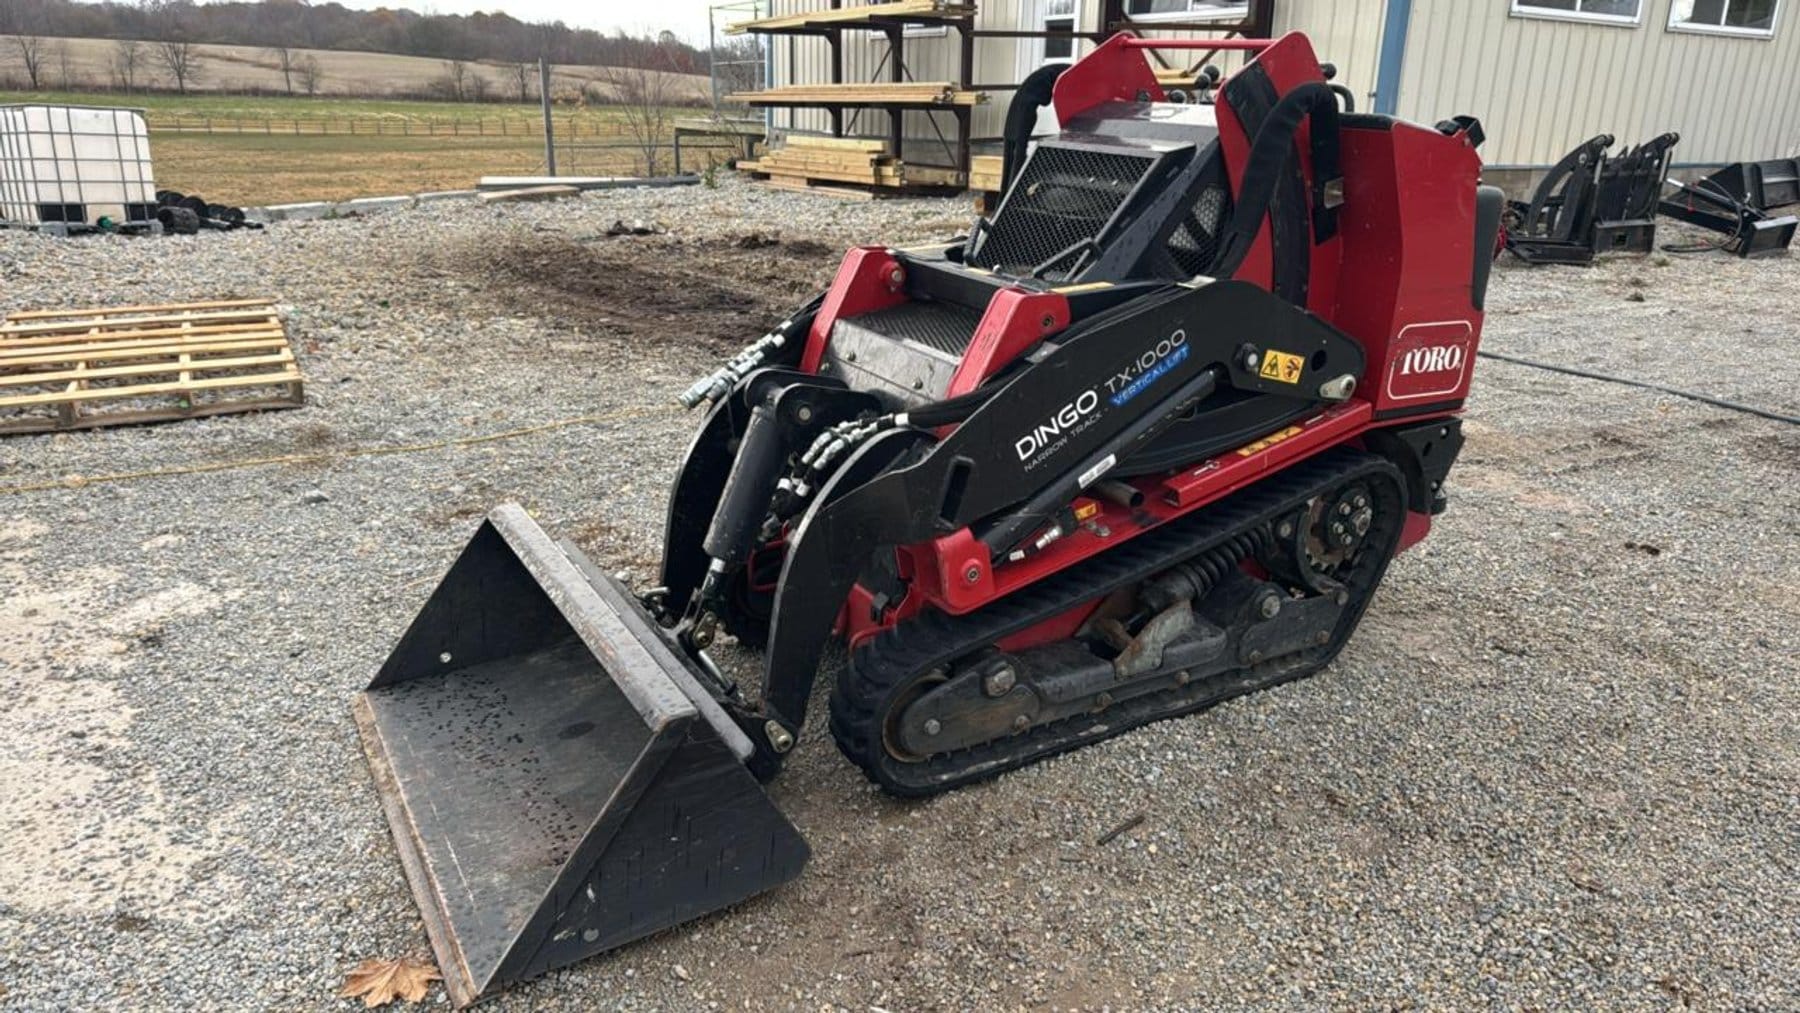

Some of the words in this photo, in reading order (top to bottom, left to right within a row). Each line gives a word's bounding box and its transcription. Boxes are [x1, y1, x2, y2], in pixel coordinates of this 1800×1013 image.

[1112, 360, 1168, 406] VERTICAL
[1167, 343, 1188, 368] LIFT
[1400, 344, 1461, 375] TORO
[1015, 390, 1098, 461] DINGO
[1024, 435, 1068, 472] NARROW
[1070, 411, 1102, 437] TRACK
